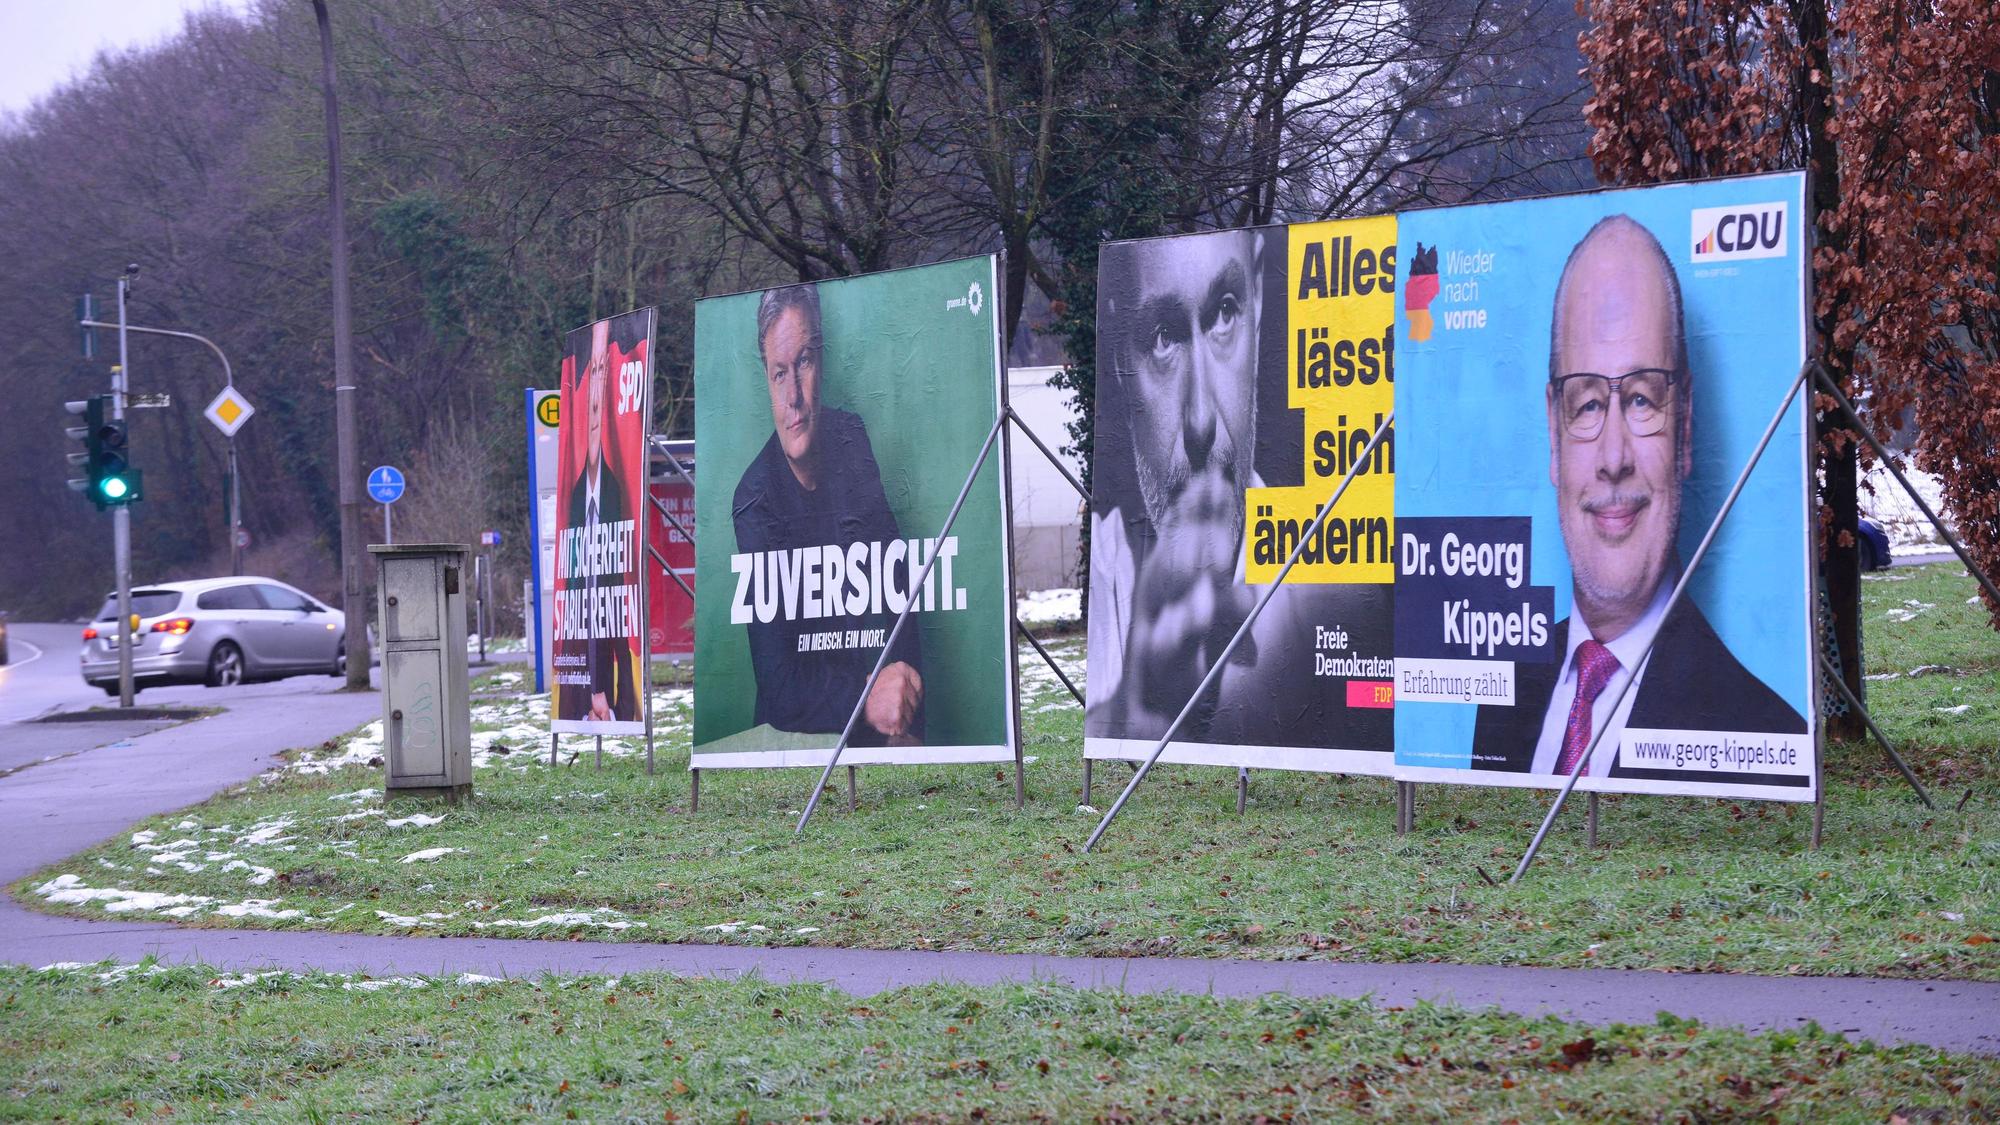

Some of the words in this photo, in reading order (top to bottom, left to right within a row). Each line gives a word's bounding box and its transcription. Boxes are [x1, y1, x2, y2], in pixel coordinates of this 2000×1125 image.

[1717, 210, 1783, 252] CDU
[1297, 235, 1396, 300] Alles
[1446, 248, 1496, 275] Wieder
[1445, 277, 1479, 303] nach
[1444, 308, 1487, 330] vorne
[1297, 323, 1395, 389] lässt
[618, 360, 643, 415] SPD
[1313, 413, 1395, 478] sich
[558, 528, 575, 579] MIT
[575, 520, 634, 578] SICHERHEIT
[1402, 533, 1436, 576] Dr.
[1441, 532, 1524, 589] Georg
[730, 536, 967, 625] ZUVERSICHT.
[554, 589, 588, 641] STABILE
[591, 584, 639, 640] RENTEN
[1443, 598, 1548, 657] Kippels
[798, 633, 811, 652] EIN
[811, 631, 843, 651] MENSCH.
[845, 630, 860, 649] EIN
[860, 628, 886, 648] WORT.
[1315, 624, 1348, 649] Freie
[1315, 651, 1395, 678] Demokraten
[1403, 669, 1472, 701] Erfahrung
[1475, 672, 1508, 697] zählt
[1374, 686, 1393, 703] FDP
[1634, 738, 1797, 770] www.georg-kippels.de
